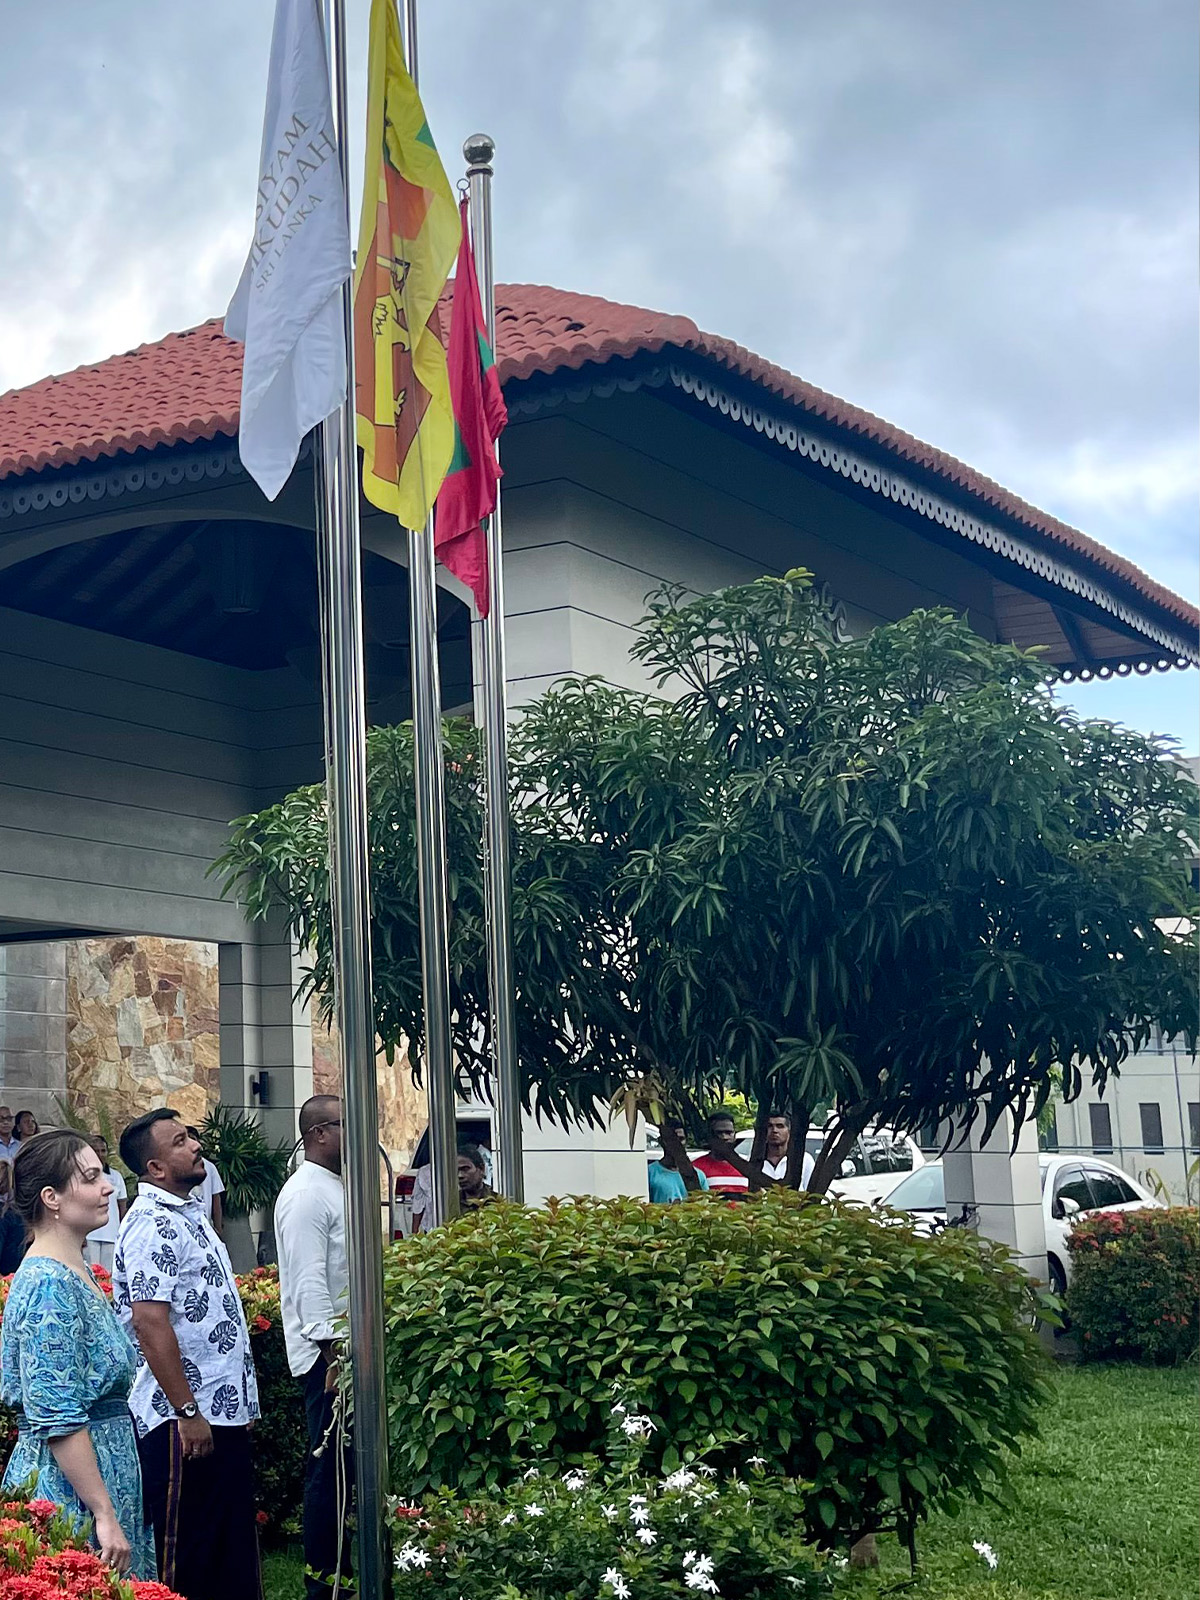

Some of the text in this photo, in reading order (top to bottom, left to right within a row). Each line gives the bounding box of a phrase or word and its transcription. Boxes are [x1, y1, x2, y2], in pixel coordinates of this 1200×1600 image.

[251, 129, 336, 274] IKUDAH
[256, 194, 323, 293] SRI LANKA
